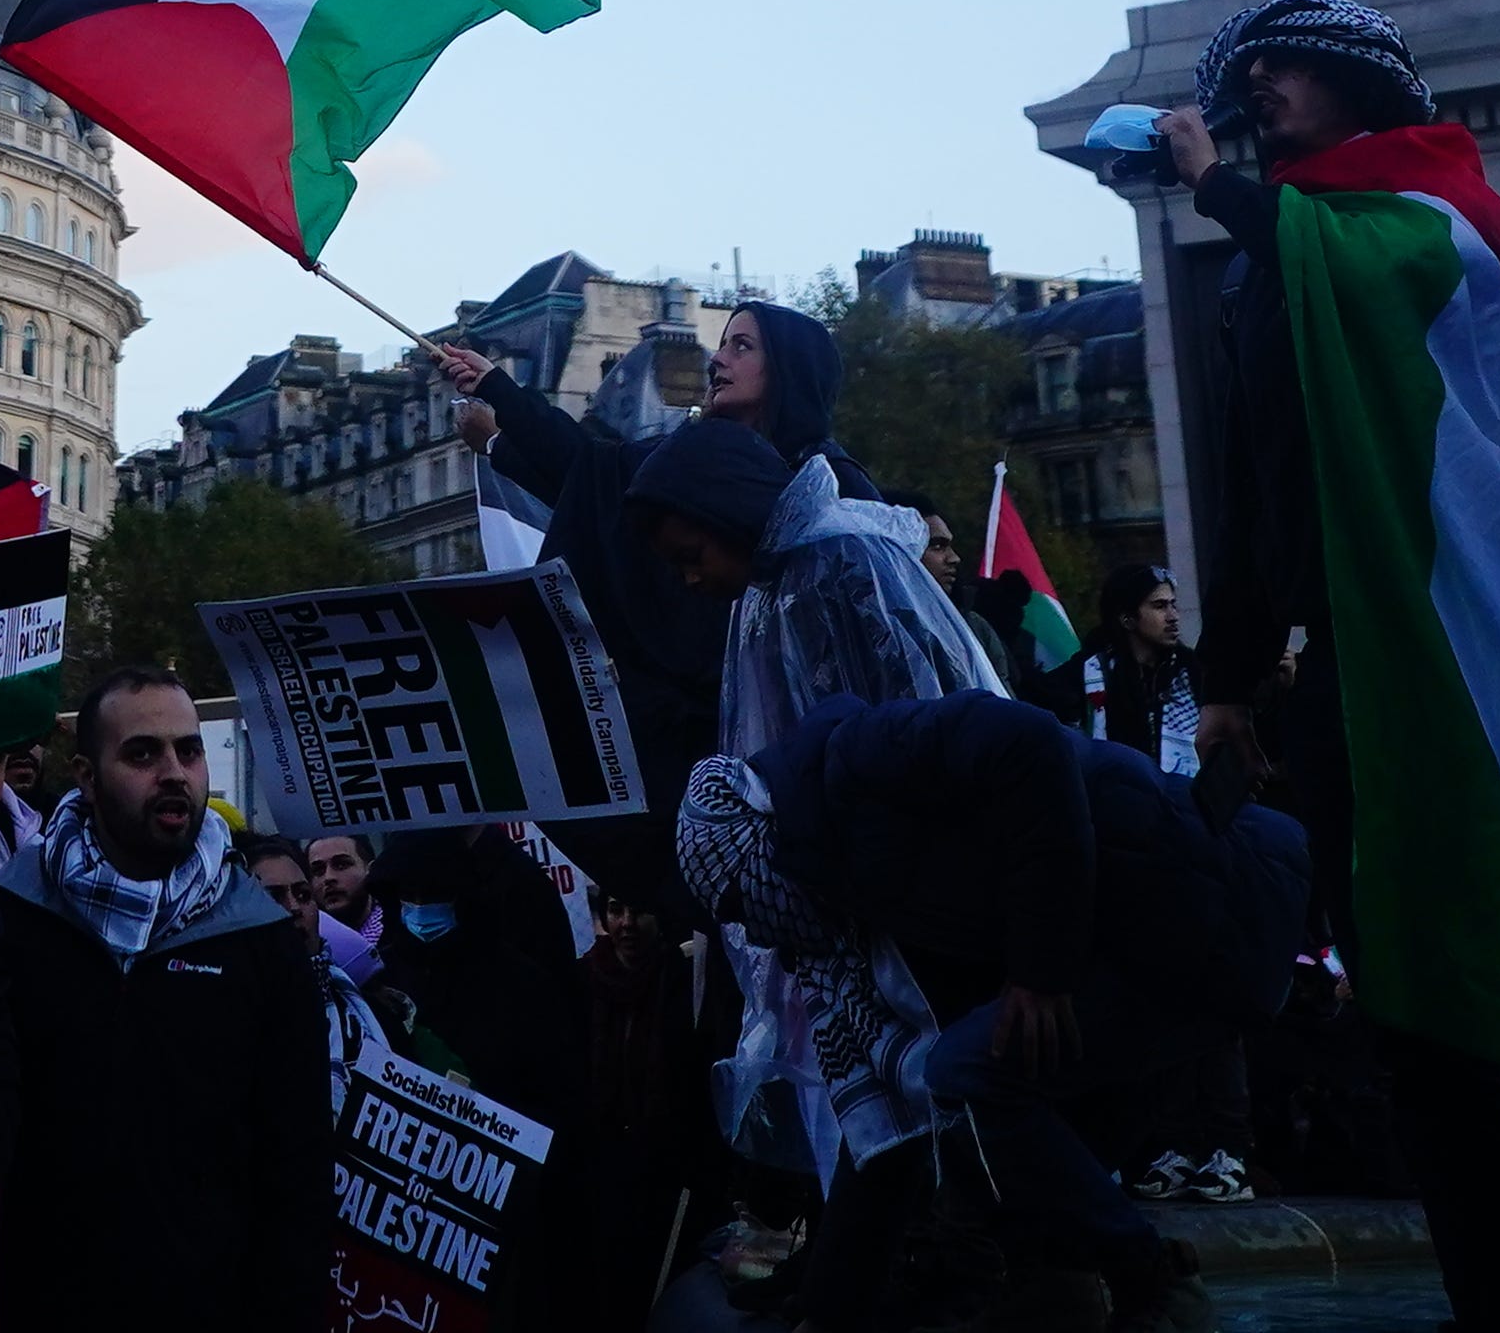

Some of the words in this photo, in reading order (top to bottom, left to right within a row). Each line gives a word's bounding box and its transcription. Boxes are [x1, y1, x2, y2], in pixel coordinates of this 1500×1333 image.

[238, 639, 297, 795] www.palestinecampaign.org
[249, 611, 278, 642] END
[269, 642, 304, 708] ISRAELI
[293, 710, 345, 827] OCCUPATION
[273, 601, 388, 825] PALESTINE
[312, 592, 481, 821] FREE
[539, 574, 578, 637] Palestine
[570, 636, 604, 722] Solidarity
[595, 718, 630, 802] Campaign
[352, 1091, 516, 1212] FREEDOM
[405, 1173, 434, 1203] for
